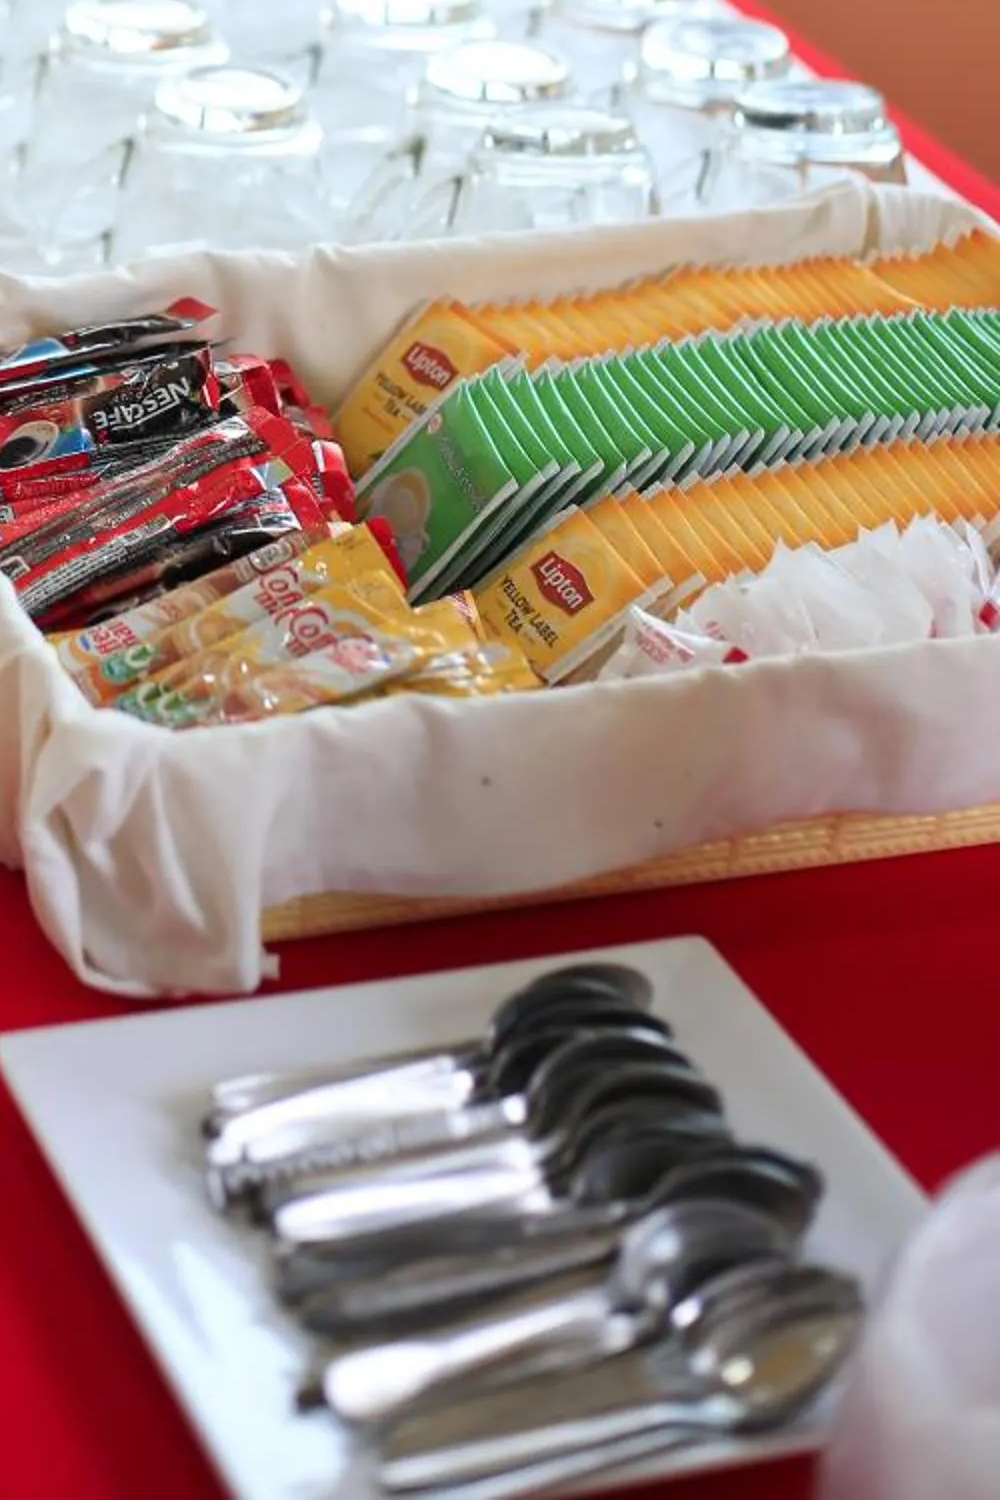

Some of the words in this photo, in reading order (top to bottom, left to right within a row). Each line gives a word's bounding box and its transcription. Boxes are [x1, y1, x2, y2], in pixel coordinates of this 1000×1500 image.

[407, 346, 453, 385] Lipton
[539, 557, 584, 609] Lipton
[502, 574, 536, 615] YELLOW
[529, 612, 560, 649] LABEL
[504, 608, 523, 634] TEA
